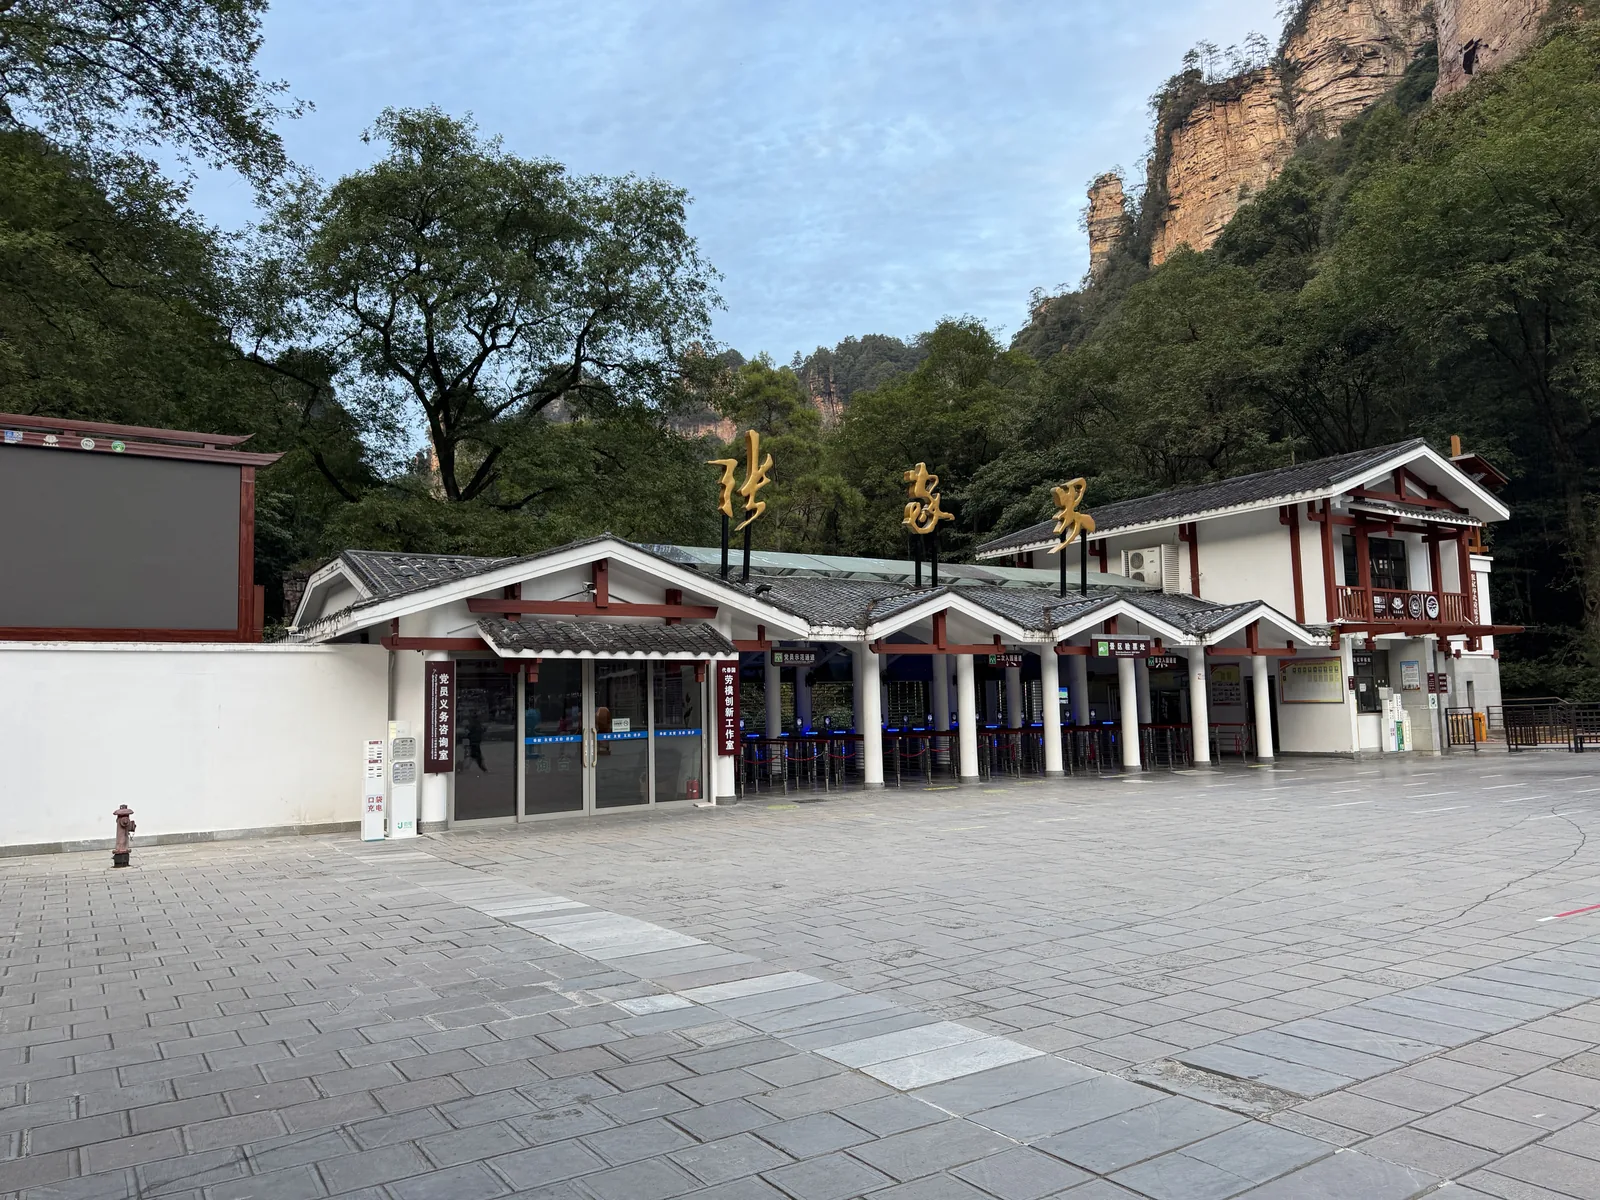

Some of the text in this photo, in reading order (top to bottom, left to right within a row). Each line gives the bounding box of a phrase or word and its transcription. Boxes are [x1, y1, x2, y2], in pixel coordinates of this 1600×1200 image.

[1109, 642, 1146, 651] 景区验票处
[438, 673, 450, 761] 党员义务咨询室
[724, 675, 735, 750] 劳模创新工作室
[367, 796, 383, 804] 口袋
[367, 804, 383, 812] 充电
